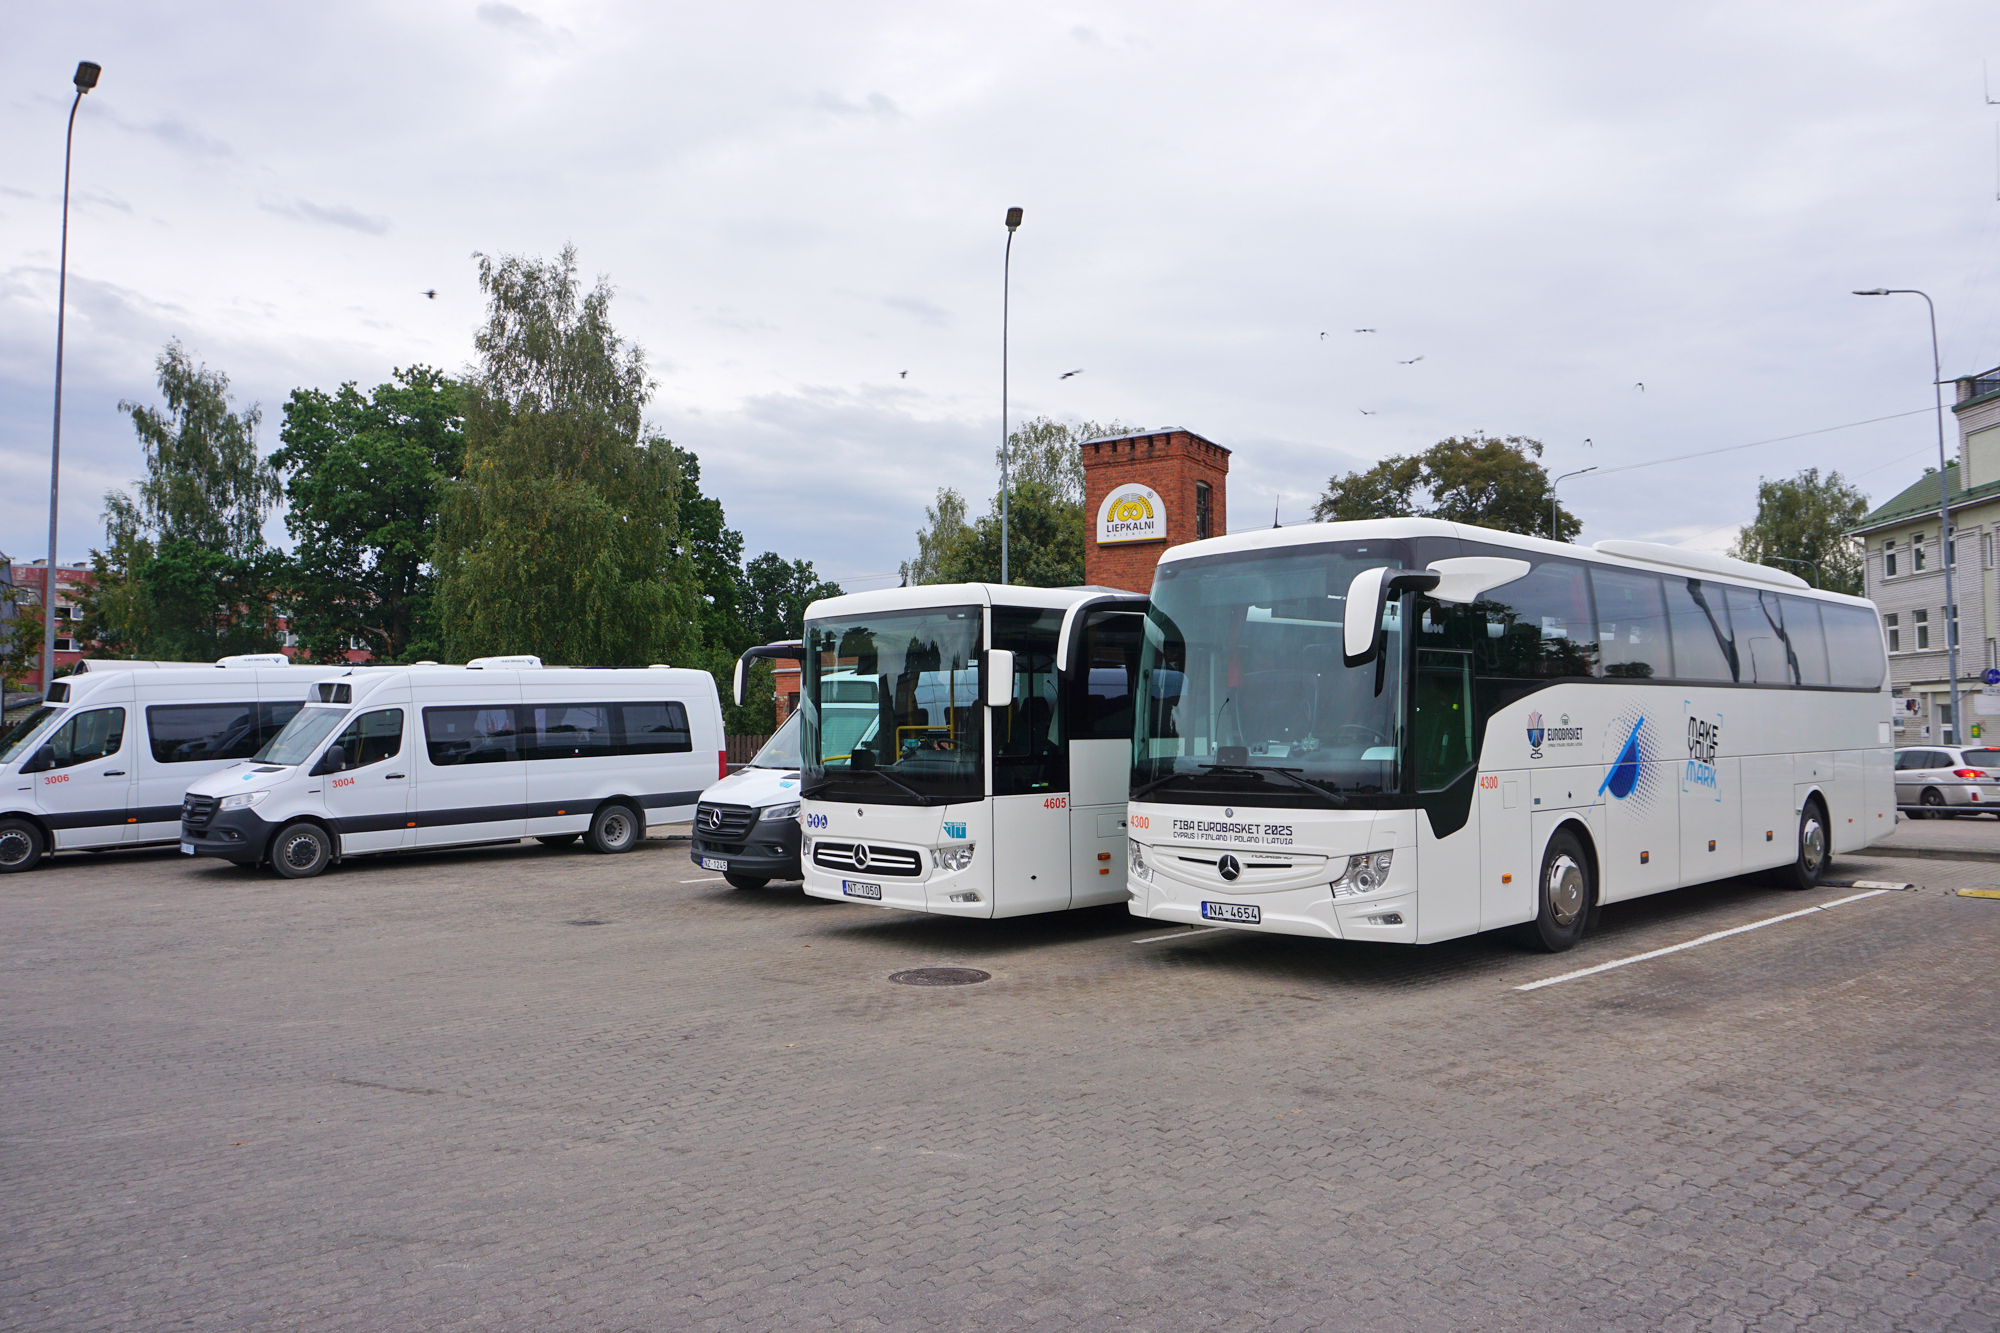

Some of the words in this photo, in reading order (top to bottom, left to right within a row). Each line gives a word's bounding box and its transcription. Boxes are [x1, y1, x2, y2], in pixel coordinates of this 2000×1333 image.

[1107, 521, 1154, 533] LIEPKALNI
[1547, 727, 1583, 741] EUROBASKET
[1688, 716, 1719, 747] MAKE
[1688, 736, 1716, 767] YOUR
[44, 773, 70, 786] 3006
[332, 776, 355, 789] 3004
[1480, 775, 1499, 790] 4300
[1686, 760, 1717, 790] MARK
[1043, 797, 1067, 810] 4605
[1130, 815, 1149, 830] 4300
[1173, 820, 1195, 831] FIBA
[1197, 821, 1261, 835] EUROBASKET
[1264, 824, 1293, 837] 2025
[1173, 831, 1196, 840] CYPRUS
[1200, 833, 1228, 842] FINLAND
[1234, 835, 1260, 844] POLAND
[1266, 837, 1293, 846] LATVIA
[847, 882, 879, 896] NT-1050
[1209, 904, 1258, 920] NA-4654
